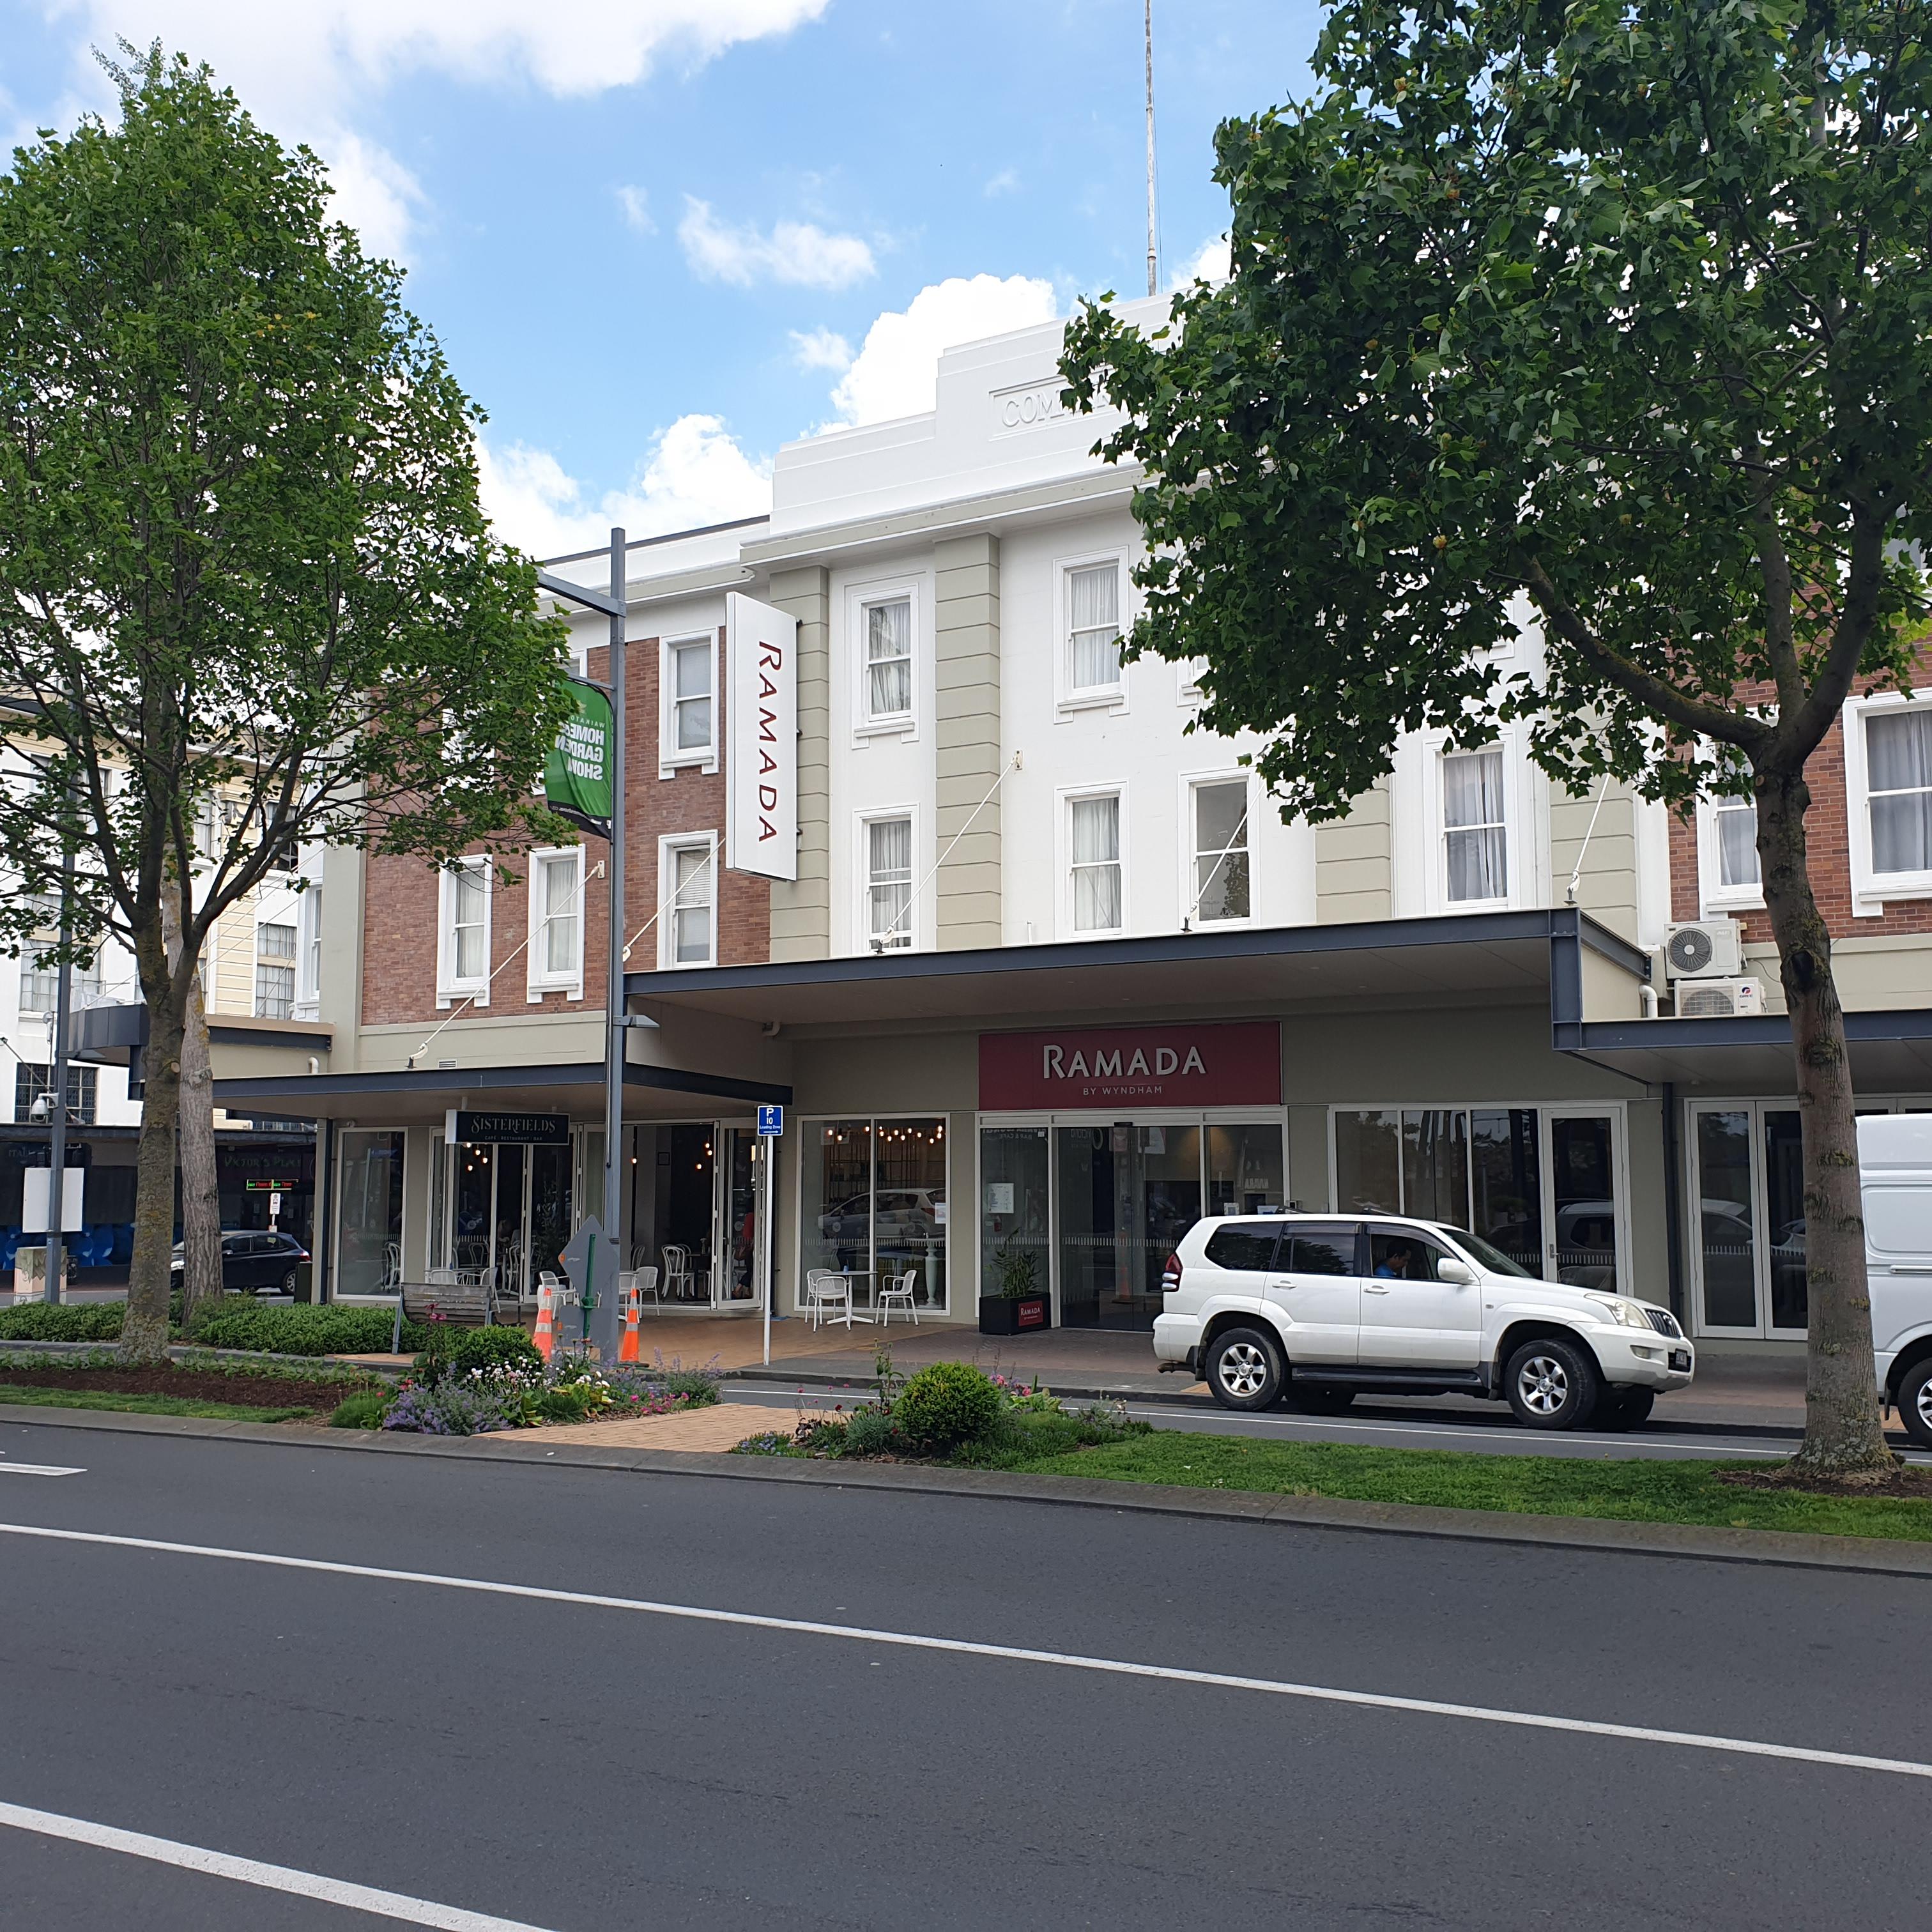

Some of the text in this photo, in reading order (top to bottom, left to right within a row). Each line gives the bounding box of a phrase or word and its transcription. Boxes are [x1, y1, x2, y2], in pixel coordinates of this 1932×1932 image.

[758, 641, 782, 843] RAMADA
[1043, 1044, 1208, 1079] RAMADA
[1083, 1085, 1162, 1096] BY WYNDHAM
[766, 1107, 774, 1117] P
[470, 1115, 556, 1134] SISTERFIELDS
[1020, 1307, 1041, 1316] RAMADA
